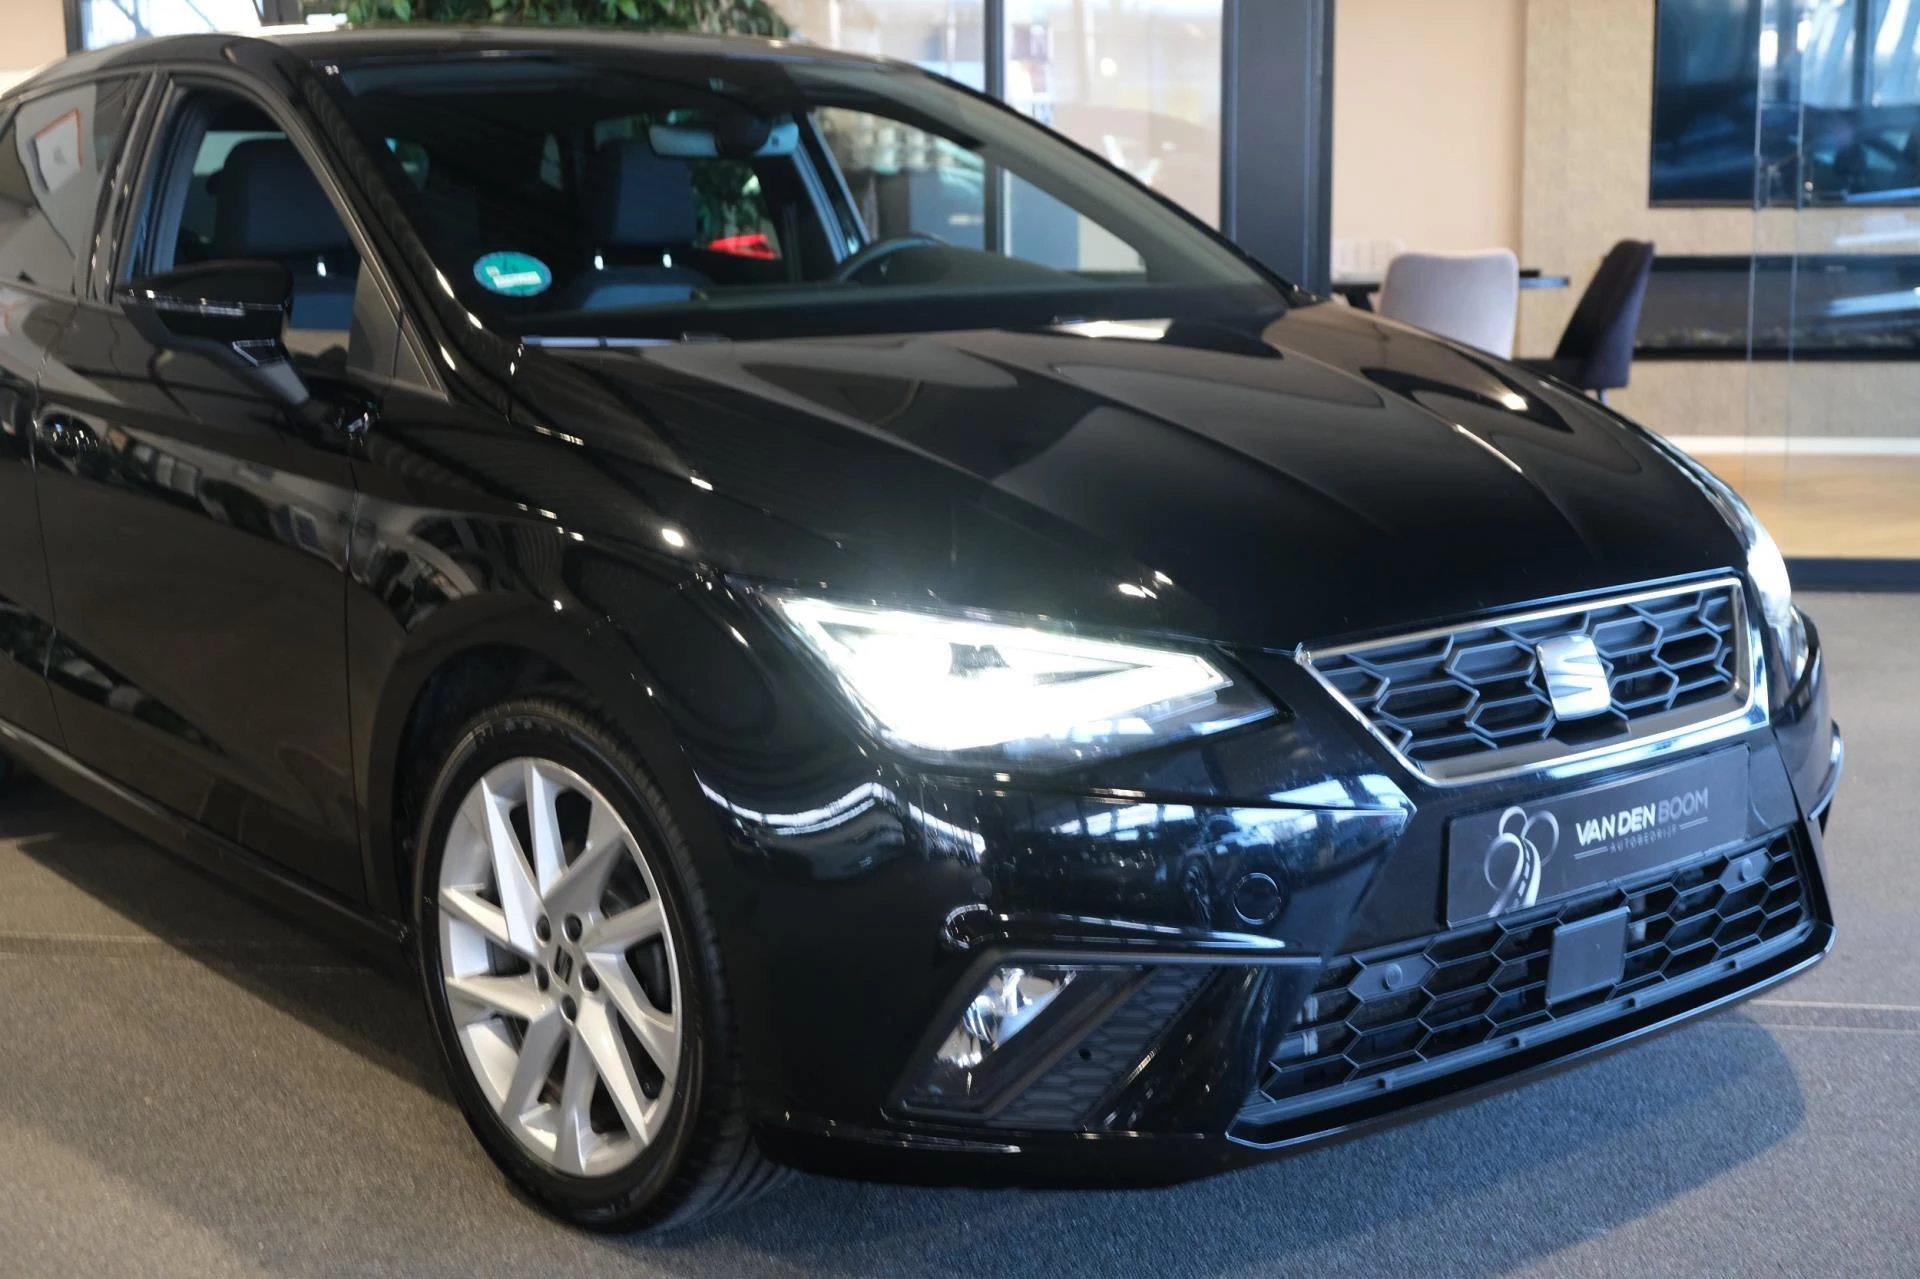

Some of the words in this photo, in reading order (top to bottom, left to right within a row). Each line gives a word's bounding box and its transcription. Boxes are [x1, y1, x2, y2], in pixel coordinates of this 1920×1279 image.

[1576, 814, 1616, 846] VAN
[1617, 803, 1656, 836] DEN
[1658, 787, 1709, 823] BOOM
